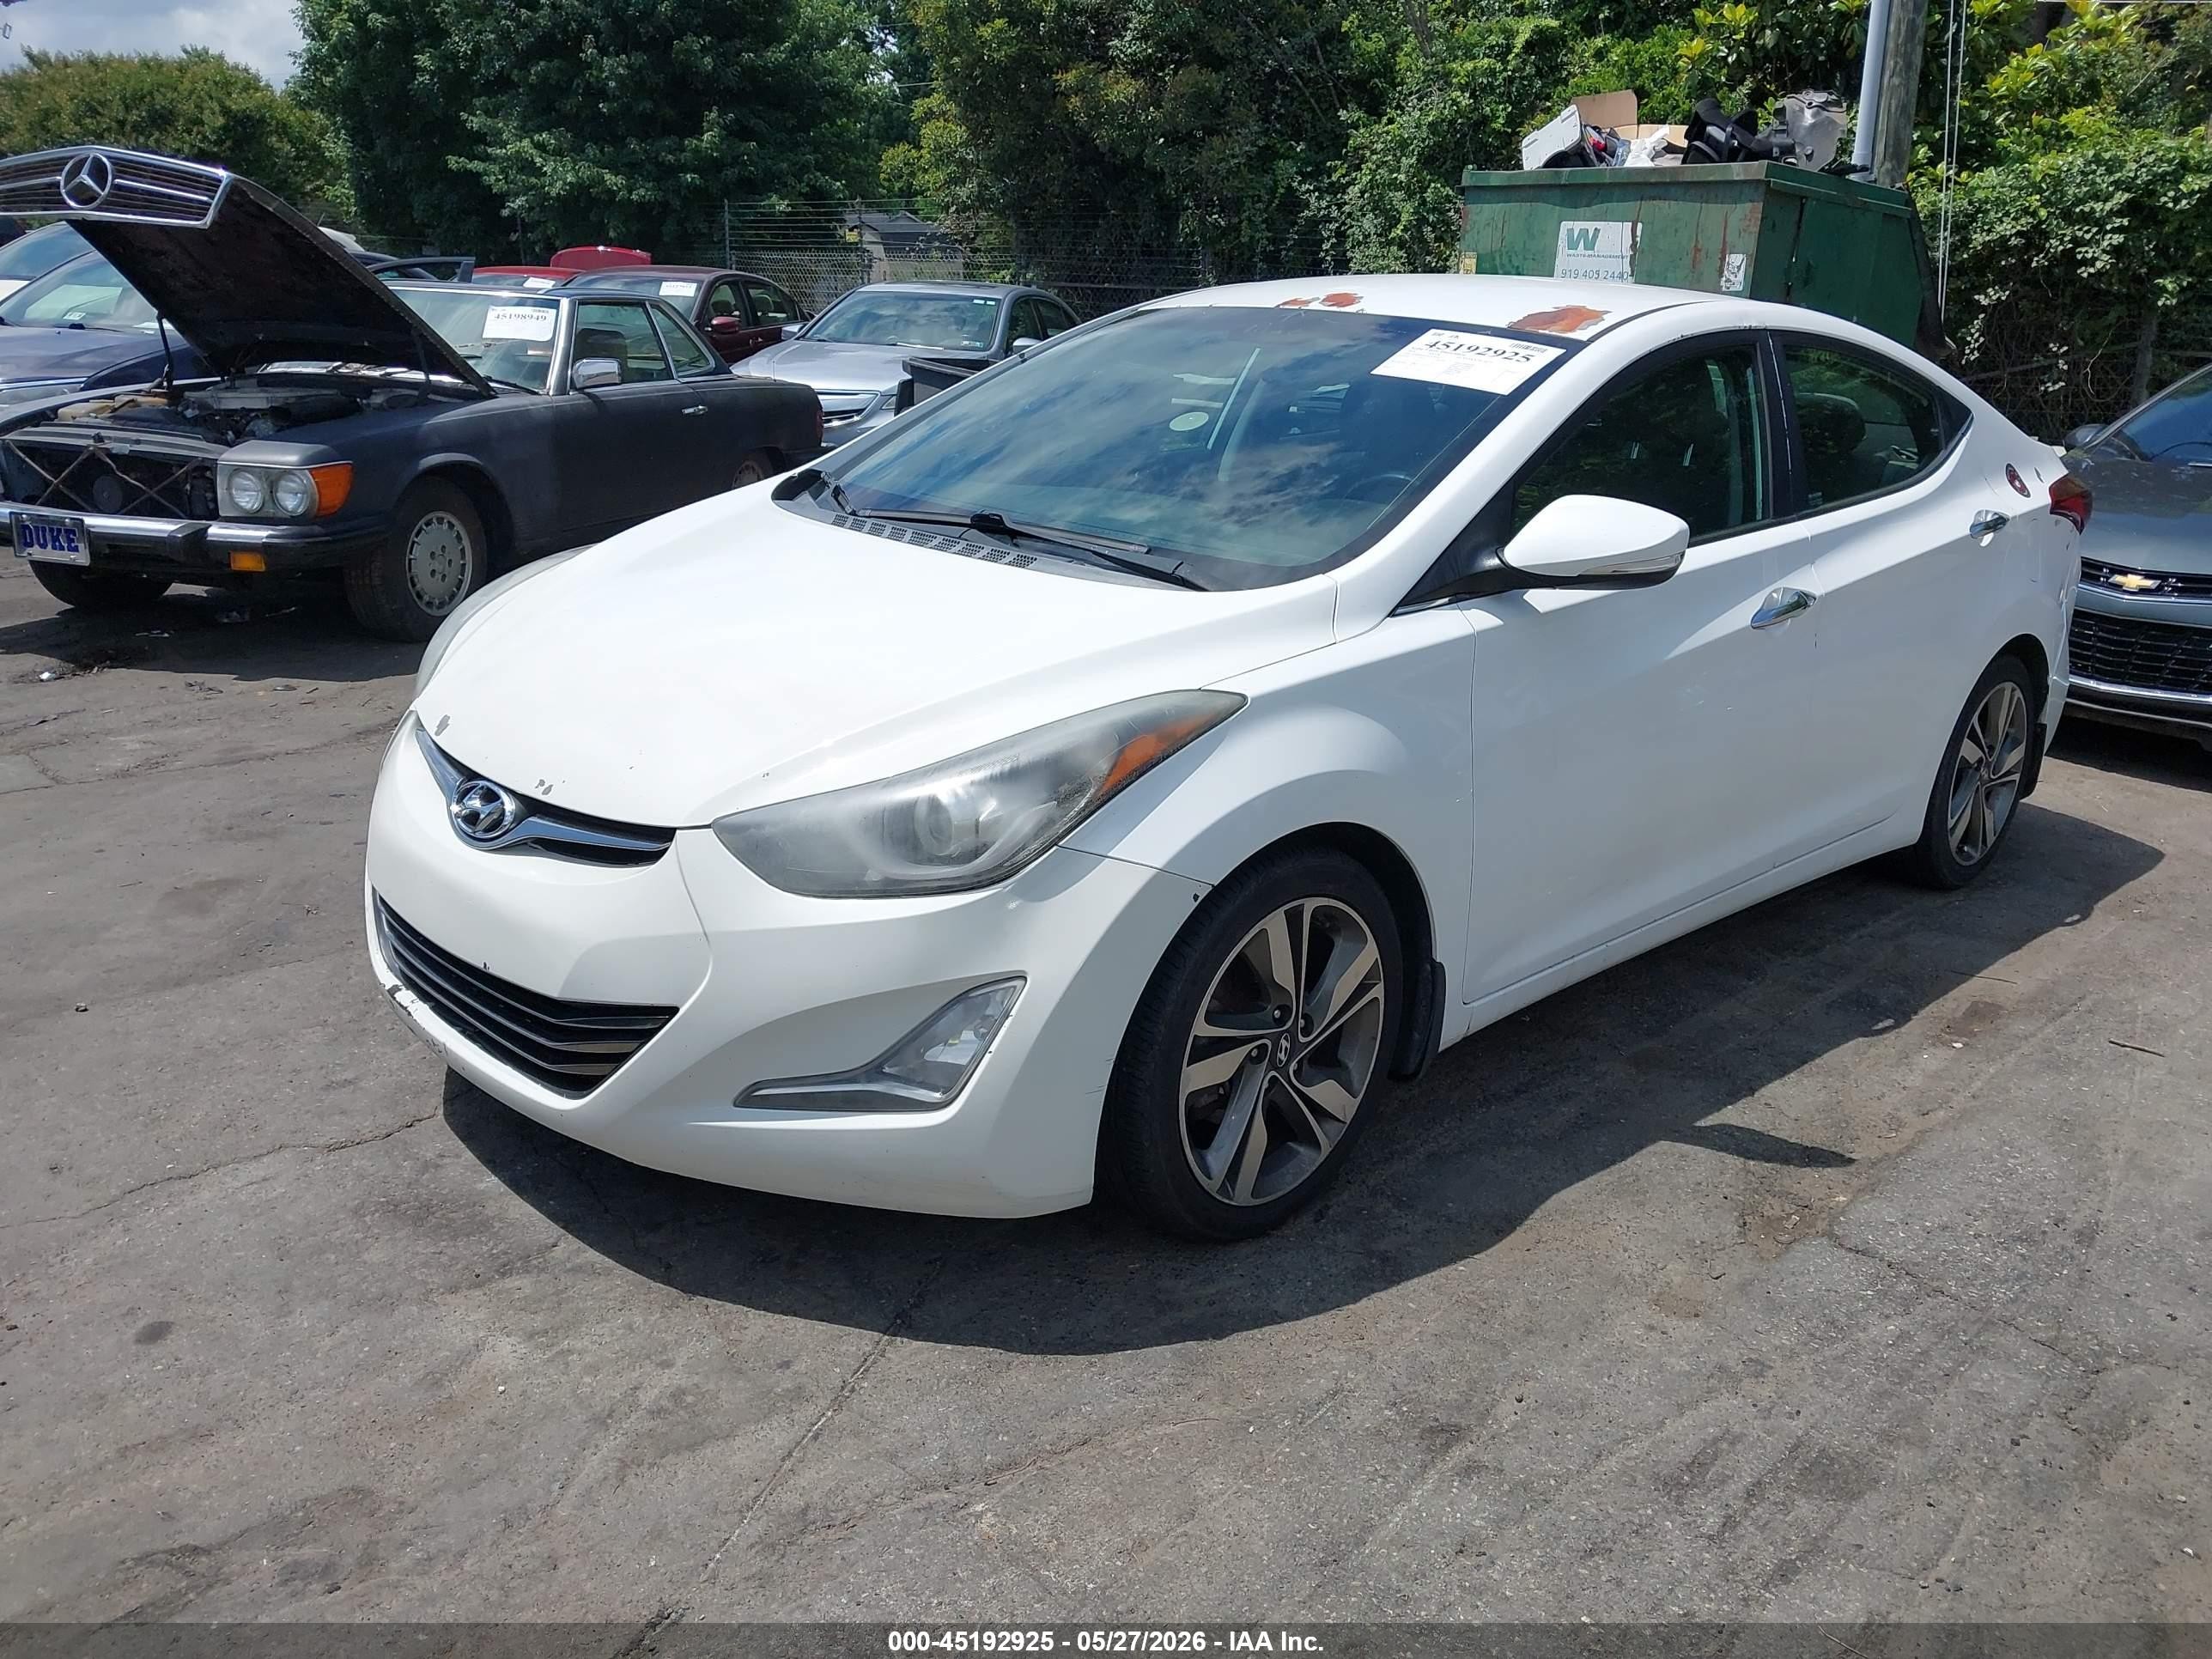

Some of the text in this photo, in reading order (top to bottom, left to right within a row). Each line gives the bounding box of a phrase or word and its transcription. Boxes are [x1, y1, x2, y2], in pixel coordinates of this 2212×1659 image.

[1561, 268, 1629, 281] 919 405 2440
[494, 313, 547, 321] 45198949
[1425, 340, 1536, 363] 45192925
[21, 524, 80, 553] DUKE
